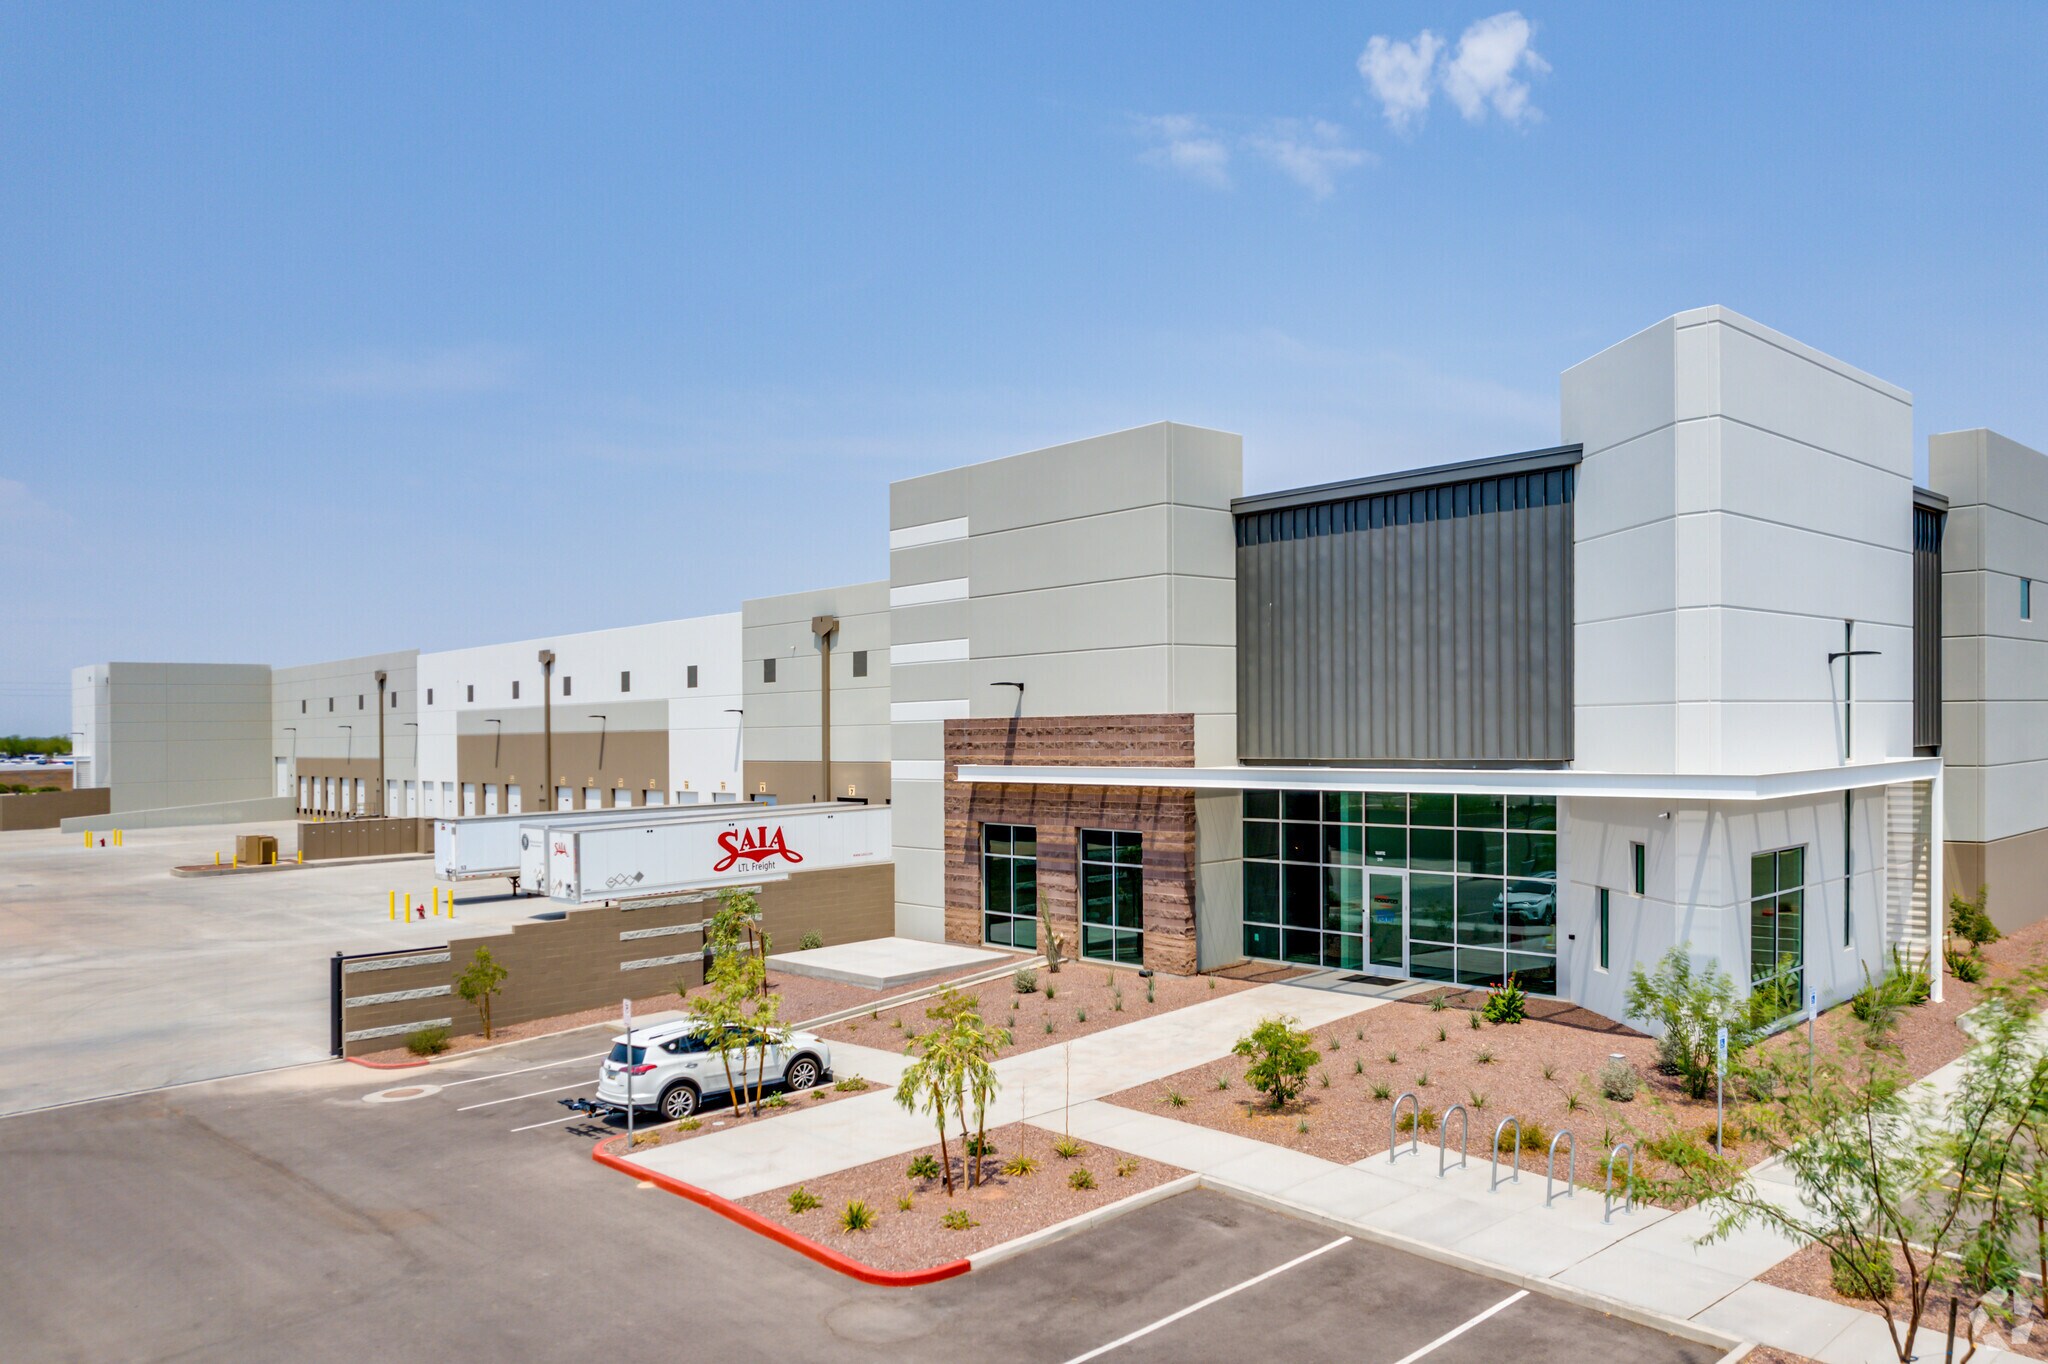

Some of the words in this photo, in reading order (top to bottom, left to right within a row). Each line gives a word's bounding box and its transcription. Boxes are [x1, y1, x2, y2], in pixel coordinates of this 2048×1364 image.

[714, 826, 803, 872] SAIA
[738, 863, 750, 872] LTL
[752, 860, 776, 872] Freight
